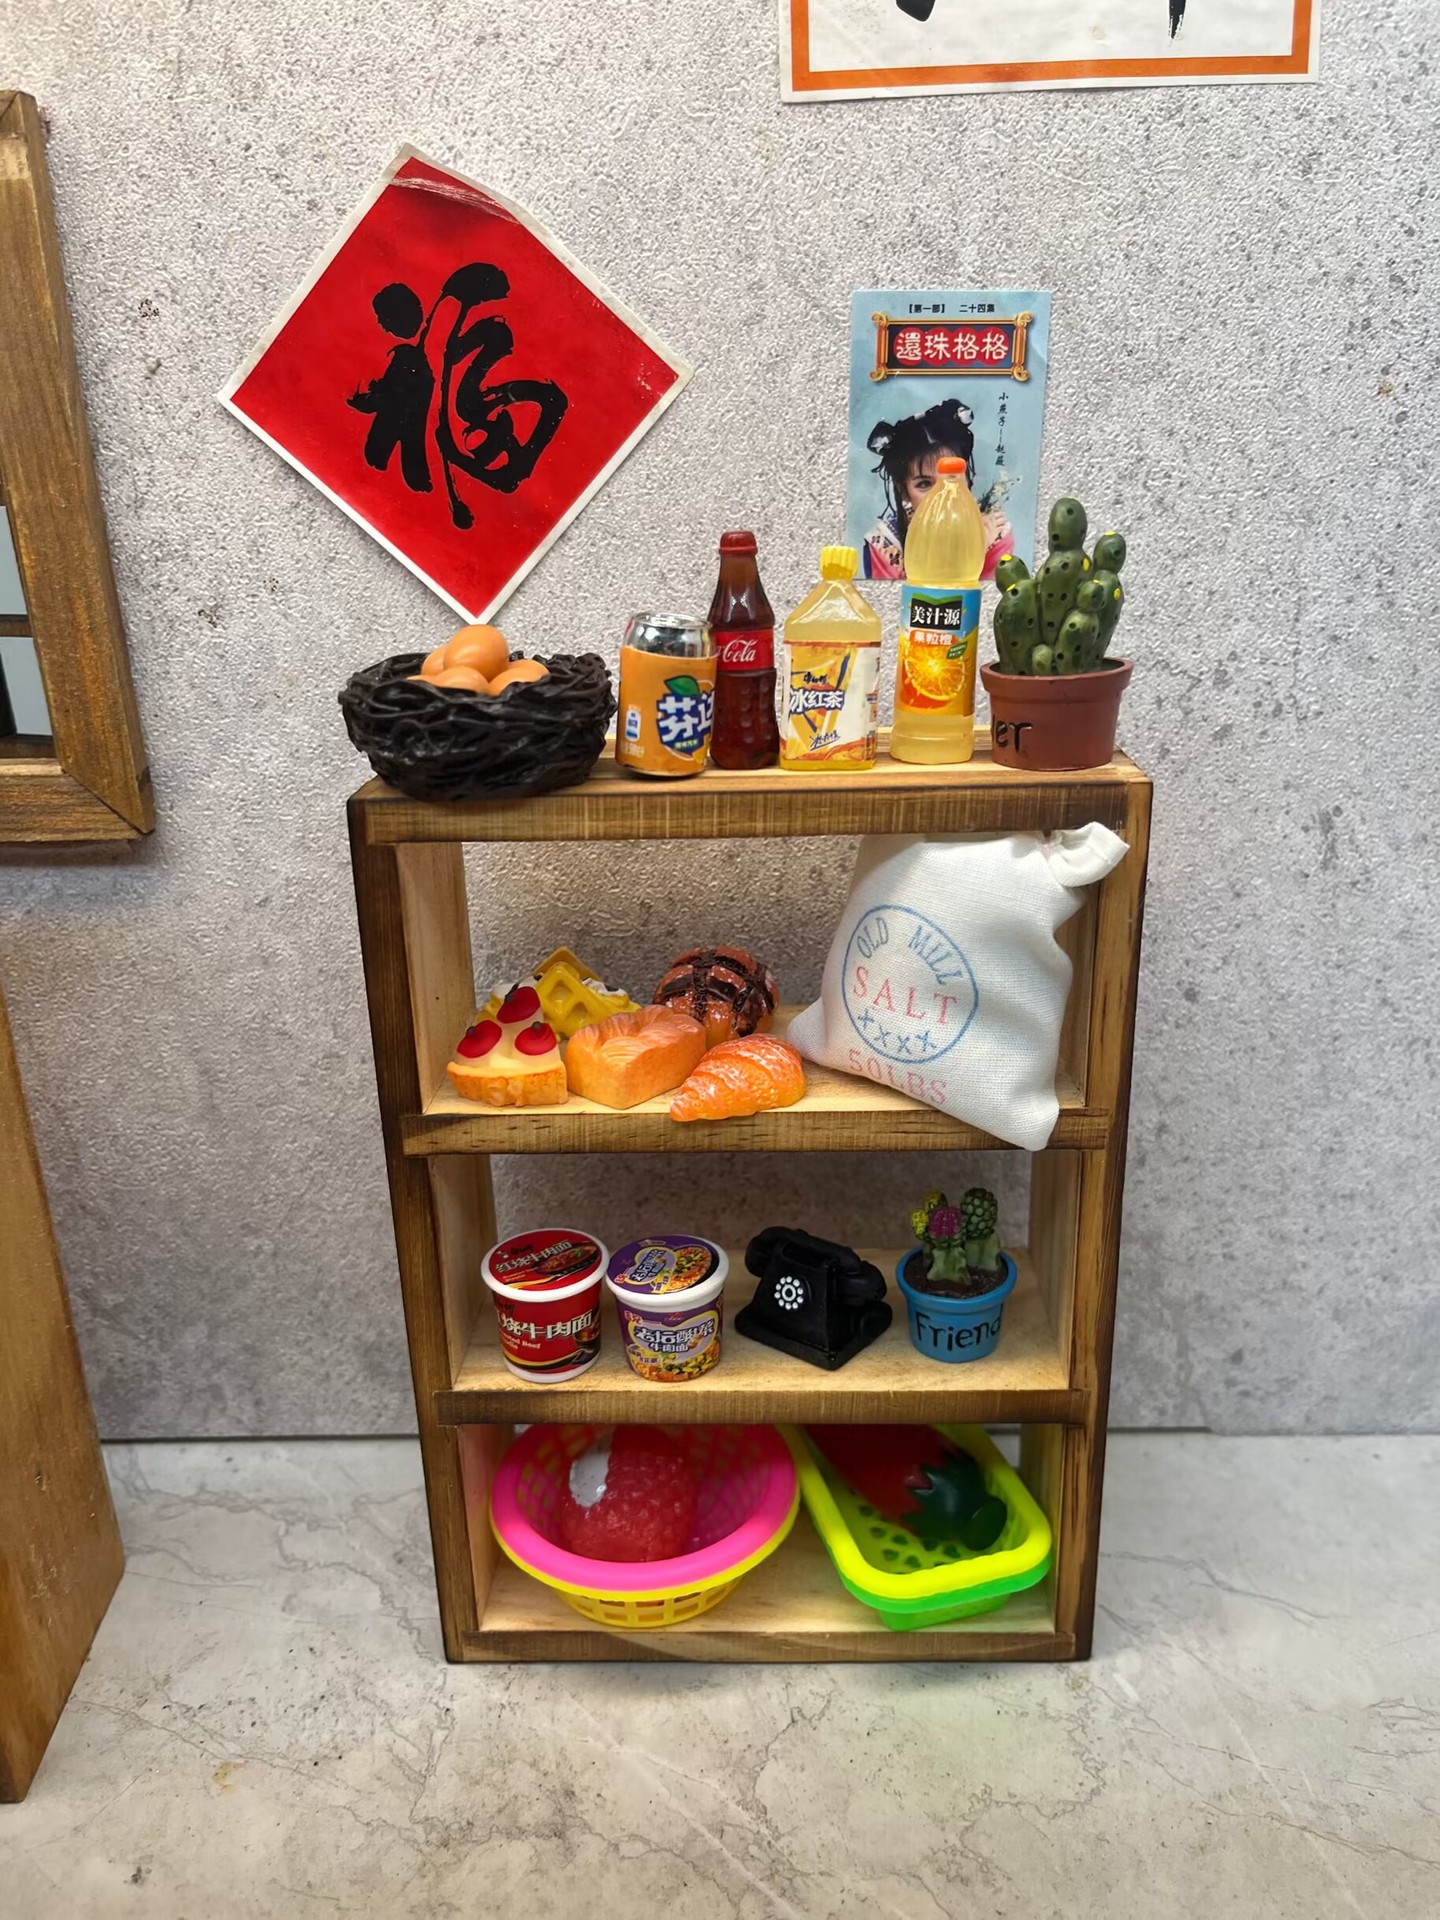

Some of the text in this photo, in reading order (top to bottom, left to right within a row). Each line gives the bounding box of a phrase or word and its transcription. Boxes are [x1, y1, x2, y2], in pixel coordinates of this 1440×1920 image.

[959, 303, 995, 313] 二十四集
[896, 331, 1009, 361] 還珠格格
[346, 262, 570, 531] 福
[911, 605, 961, 626] 美汁源
[914, 631, 953, 646] 果粒橙
[789, 689, 845, 714] 冰红茶
[991, 714, 1033, 753] er
[856, 916, 964, 986] OLD MILL
[852, 965, 958, 1027] SALT
[495, 1240, 573, 1273] 红烧牛肉面
[498, 1309, 593, 1340] 烧牛肉面
[915, 1302, 1004, 1352] Friend
